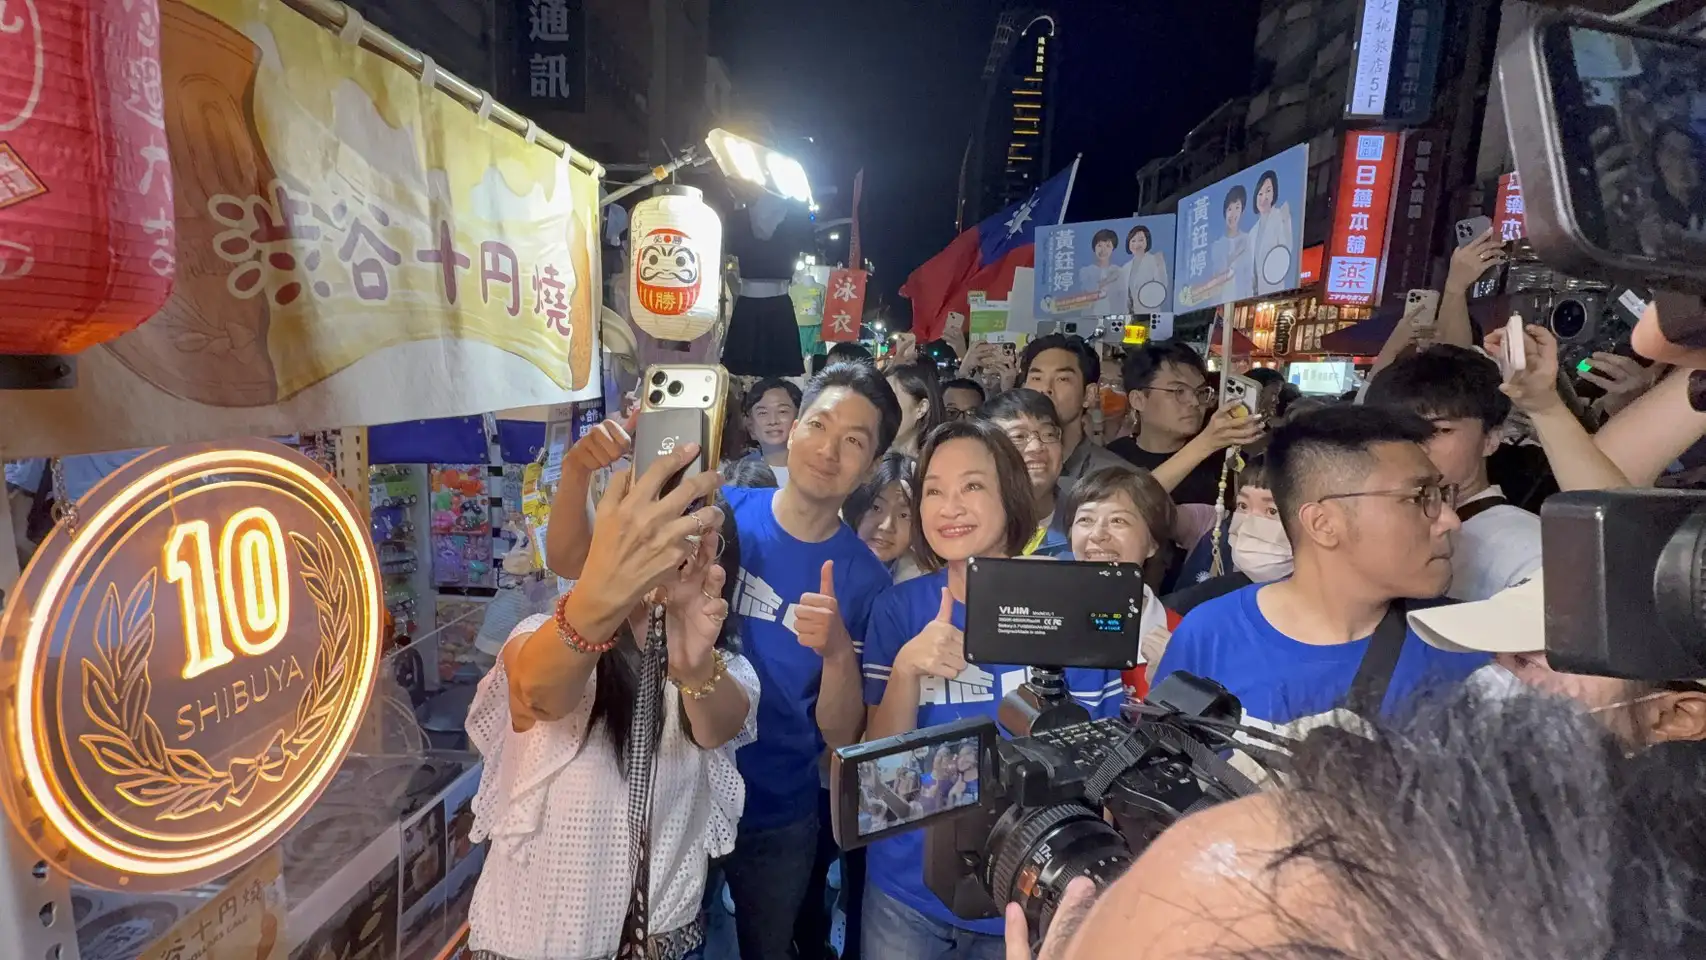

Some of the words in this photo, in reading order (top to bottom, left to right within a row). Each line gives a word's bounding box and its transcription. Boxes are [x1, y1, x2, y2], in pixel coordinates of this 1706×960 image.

[528, 0, 569, 98] 通訊
[1346, 165, 1377, 254] 日藥本舖
[1053, 229, 1075, 292] 黃鈺婷
[656, 291, 677, 310] 勝
[828, 277, 858, 334] 泳衣
[163, 507, 290, 680] 10
[999, 606, 1029, 615] VIJIM
[177, 655, 305, 741] SHIBUYA
[1039, 843, 1053, 860] 17x
